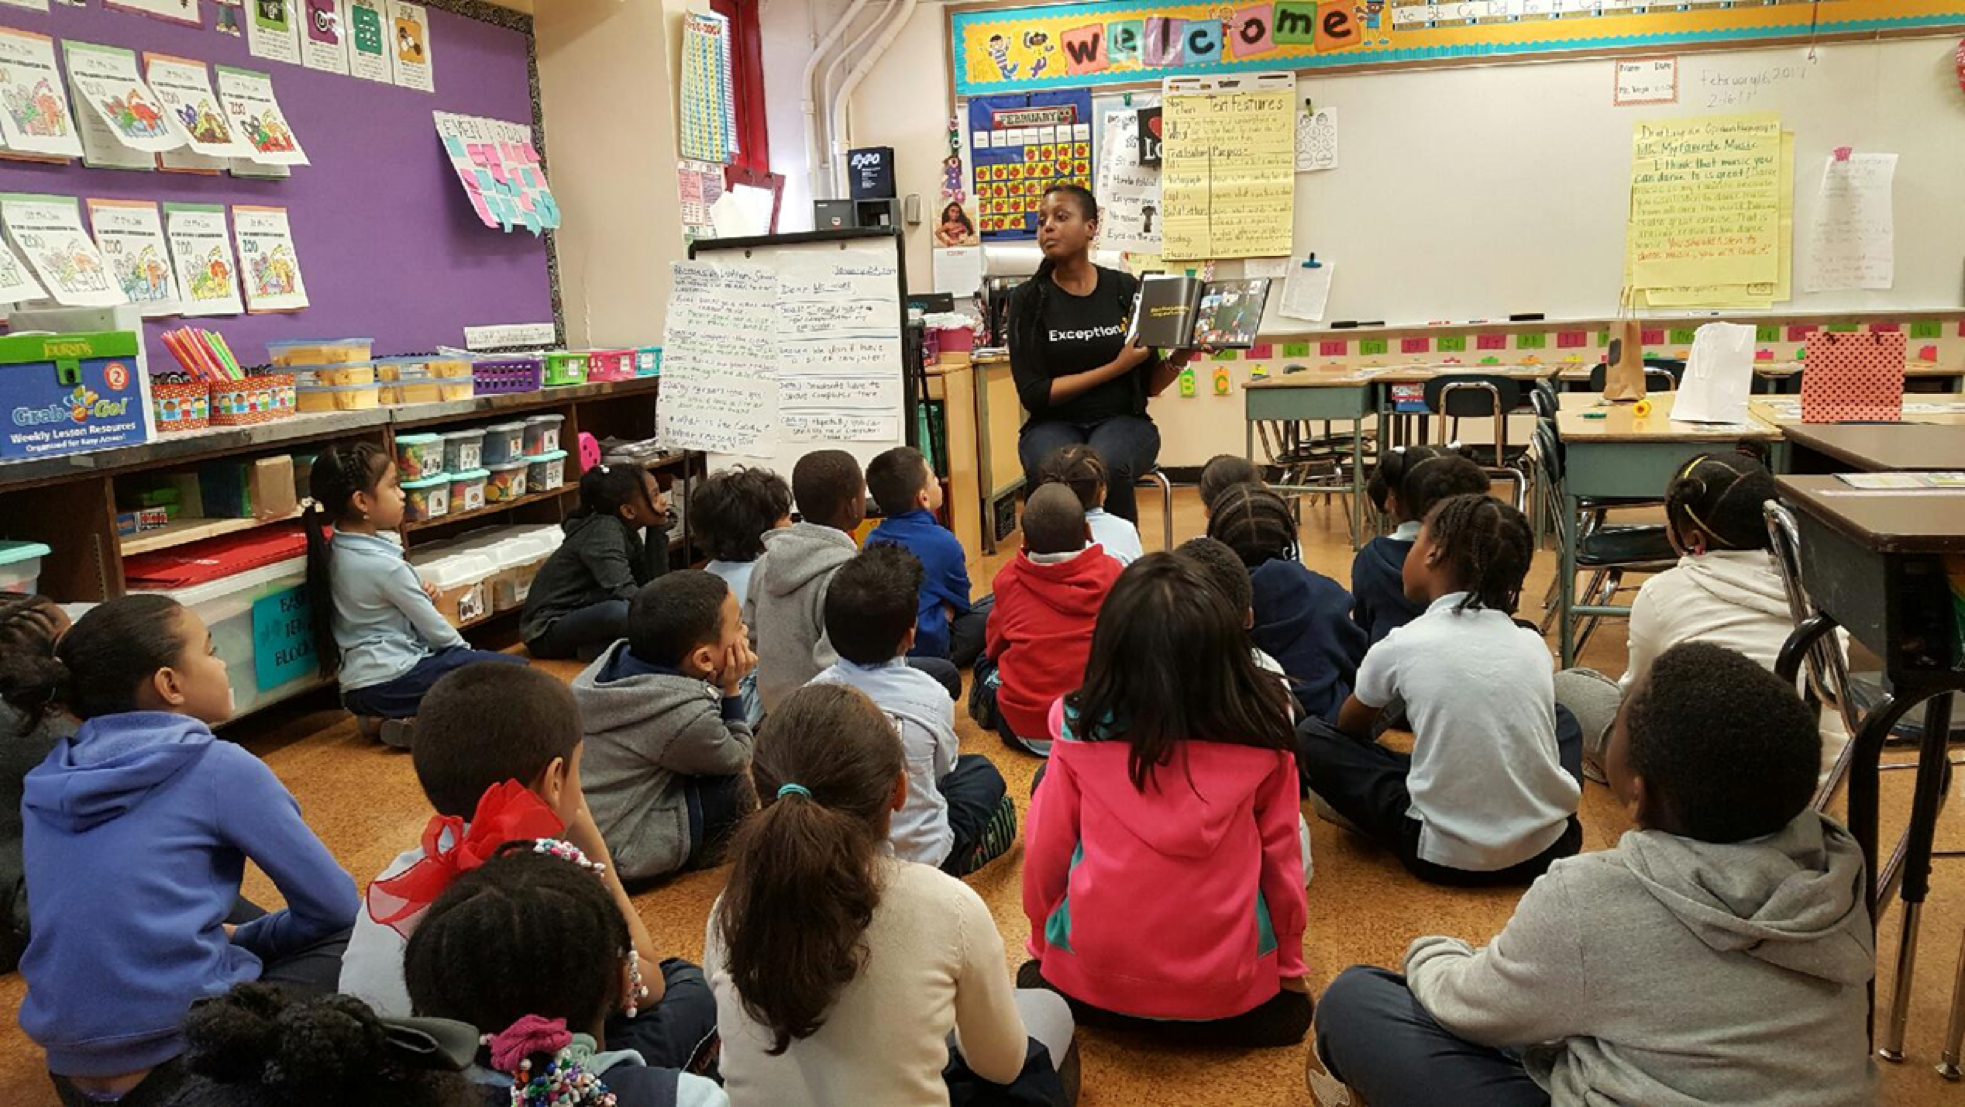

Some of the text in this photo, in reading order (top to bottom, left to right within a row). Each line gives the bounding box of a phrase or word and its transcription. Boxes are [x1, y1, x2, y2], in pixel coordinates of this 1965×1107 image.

[1065, 9, 1352, 65] welcome
[1231, 92, 1284, 112] Features
[1694, 157, 1717, 169] that
[112, 370, 122, 382] 2
[1180, 375, 1196, 396] B
[1213, 375, 1229, 394] C
[10, 421, 136, 446] Weekly Lesson Resources
